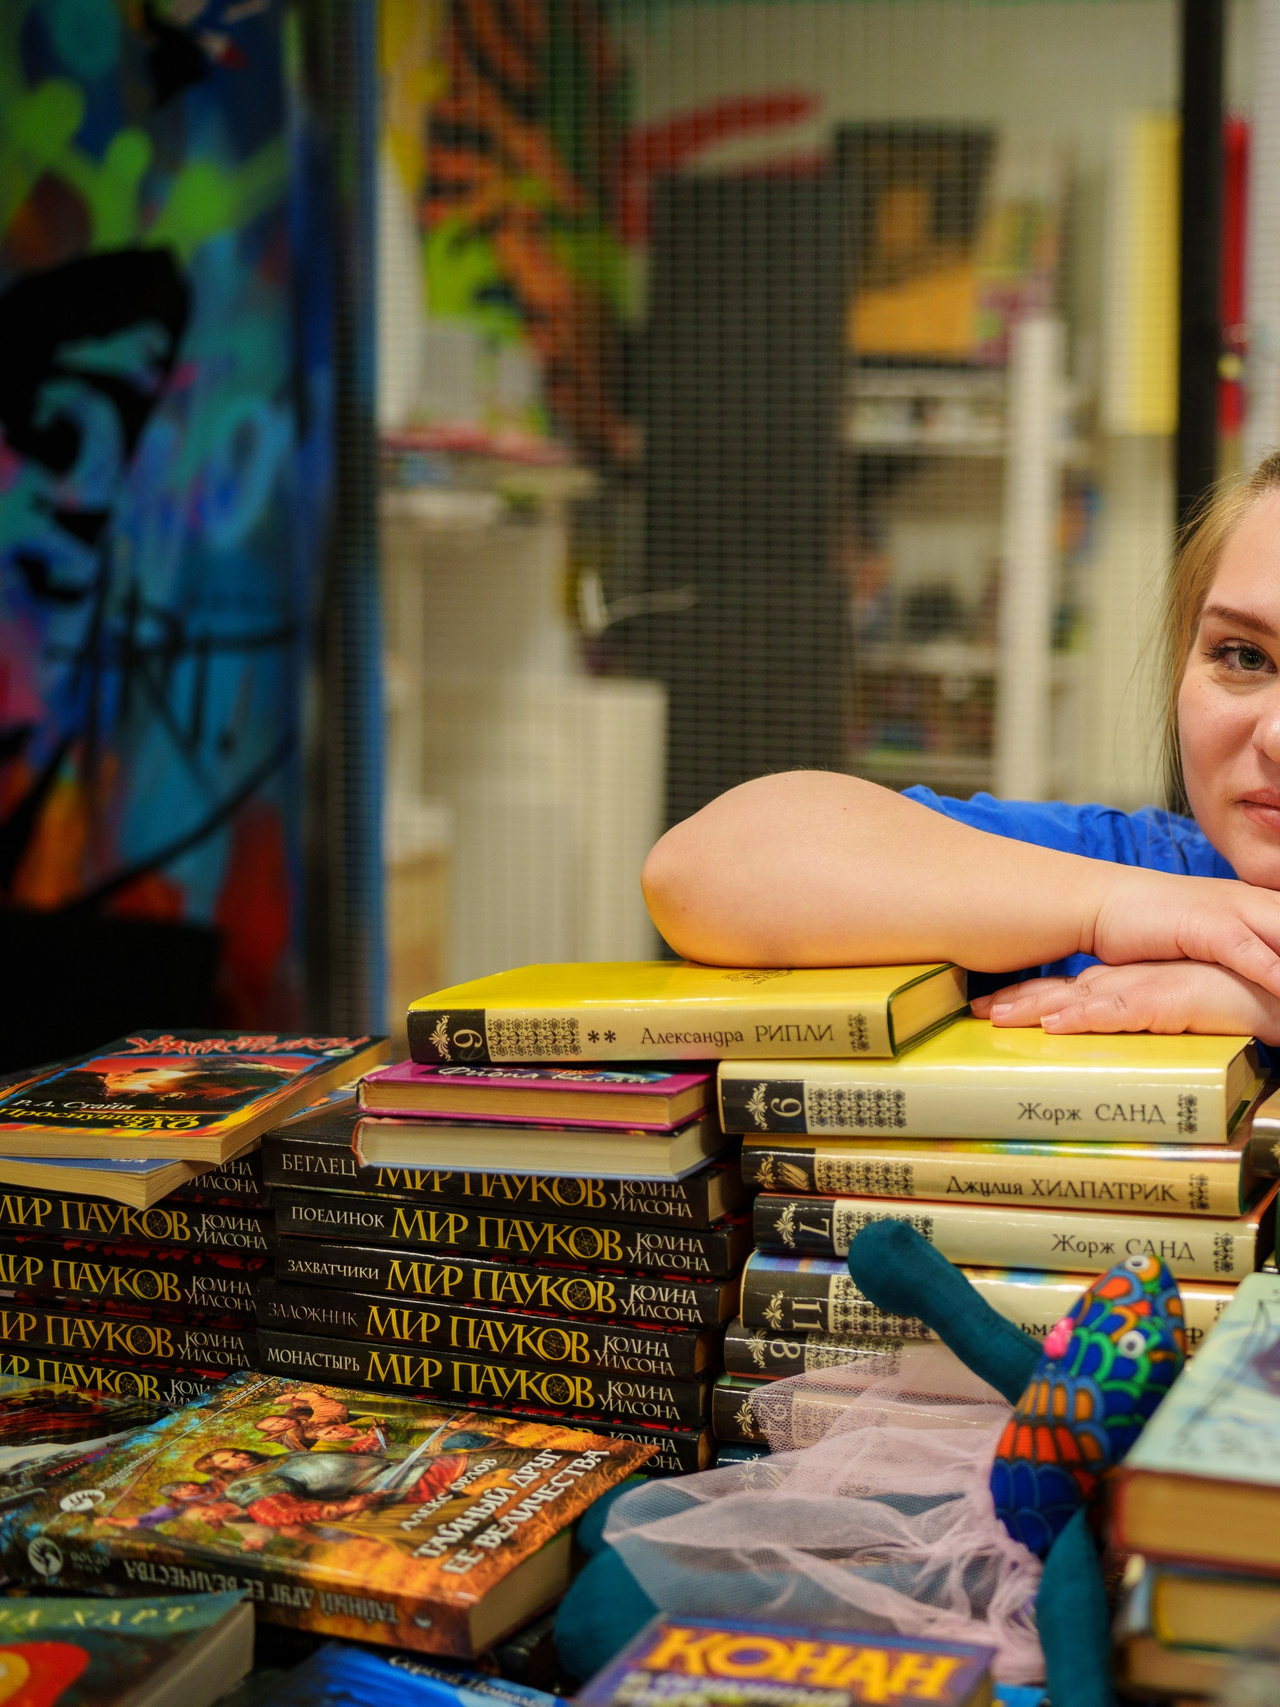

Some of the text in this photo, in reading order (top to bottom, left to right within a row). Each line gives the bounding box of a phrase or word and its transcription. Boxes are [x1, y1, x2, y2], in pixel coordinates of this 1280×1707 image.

[640, 1023, 834, 1048] Александра РИПЛИ
[1018, 1102, 1167, 1126] Жорж САНД
[281, 1153, 607, 1208] БЕГЛЕЦ МИР ПАУКОВ
[619, 1180, 687, 1199] КОЛИНА
[946, 1175, 1180, 1202] Джулия ХИЛПАТРИК
[609, 1192, 693, 1218] УИЛСОНА
[59, 1200, 191, 1241] ПАУКОВ
[201, 1213, 262, 1233] КОЛИНА
[193, 1226, 268, 1250] УИЛСОНА
[291, 1206, 623, 1262] ПОЕДИНОК МИР ПАУКОВ
[636, 1232, 705, 1254] КОЛИНА
[1051, 1233, 1196, 1261] Жорж САНД
[626, 1246, 711, 1272] УИЛСОНА
[51, 1258, 182, 1302] ПАУКОВ
[191, 1275, 252, 1296] КОЛИНА
[287, 1259, 617, 1314] ЗАХВАТЧИКИ МИР ПАУКОВ
[183, 1288, 257, 1312] УИЛСОНА
[629, 1284, 698, 1306] КОЛИНА
[619, 1299, 704, 1324] УИЛСОНА
[44, 1315, 175, 1358] ПАУКОВ
[184, 1330, 245, 1351] КОЛИНА
[268, 1302, 591, 1363] ЗАЛОЖНИК МИР ПАУКОВ
[176, 1343, 251, 1368] УИЛСОНА
[603, 1335, 671, 1358] КОЛИНА
[592, 1349, 676, 1376] УИЛСОНА
[36, 1358, 160, 1400] ПАУКОВ
[267, 1348, 595, 1409] МОНАСТЫРЬ МИР ПАУКОВ
[607, 1380, 675, 1402] КОЛИНА
[597, 1394, 681, 1420] УИЛСОНА
[400, 1457, 499, 1532] АЛЕКС ОРЛОВ
[412, 1447, 564, 1559] ТАЙНЫЙ ДРУГ
[440, 1449, 611, 1576] ЕЕ ВЕЛИЧЕСТВА
[643, 1625, 965, 1704] КОНАН
